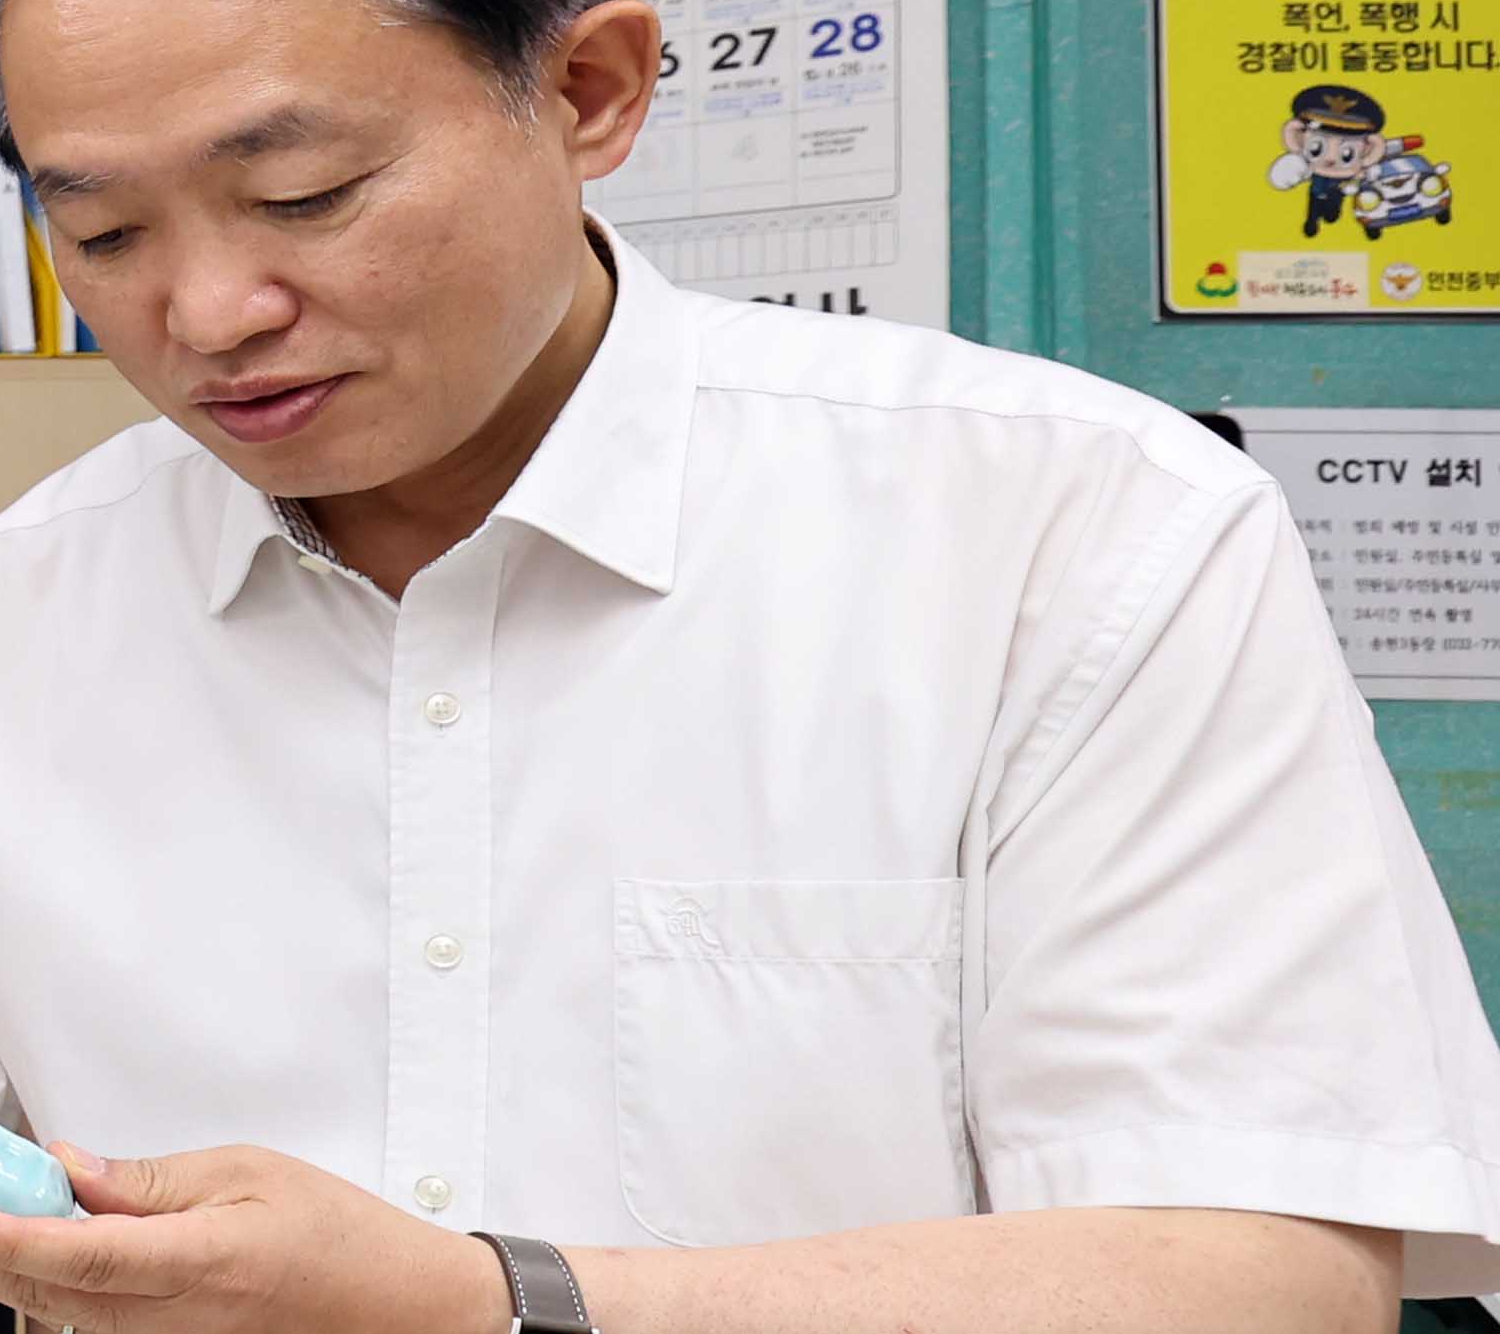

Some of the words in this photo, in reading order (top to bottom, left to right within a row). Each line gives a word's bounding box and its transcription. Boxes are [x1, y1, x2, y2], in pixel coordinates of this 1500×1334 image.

[1282, 2, 1351, 32] 폭언,
[1359, 2, 1420, 32] 폭행
[1429, 2, 1460, 32] 시
[656, 41, 680, 79] 6
[709, 27, 778, 72] 27
[809, 13, 882, 60] 28
[1237, 41, 1329, 73] 경찰이
[1340, 41, 1500, 73] 출동합니다.
[1317, 459, 1409, 484] CCTV
[1425, 458, 1482, 487] 설치
